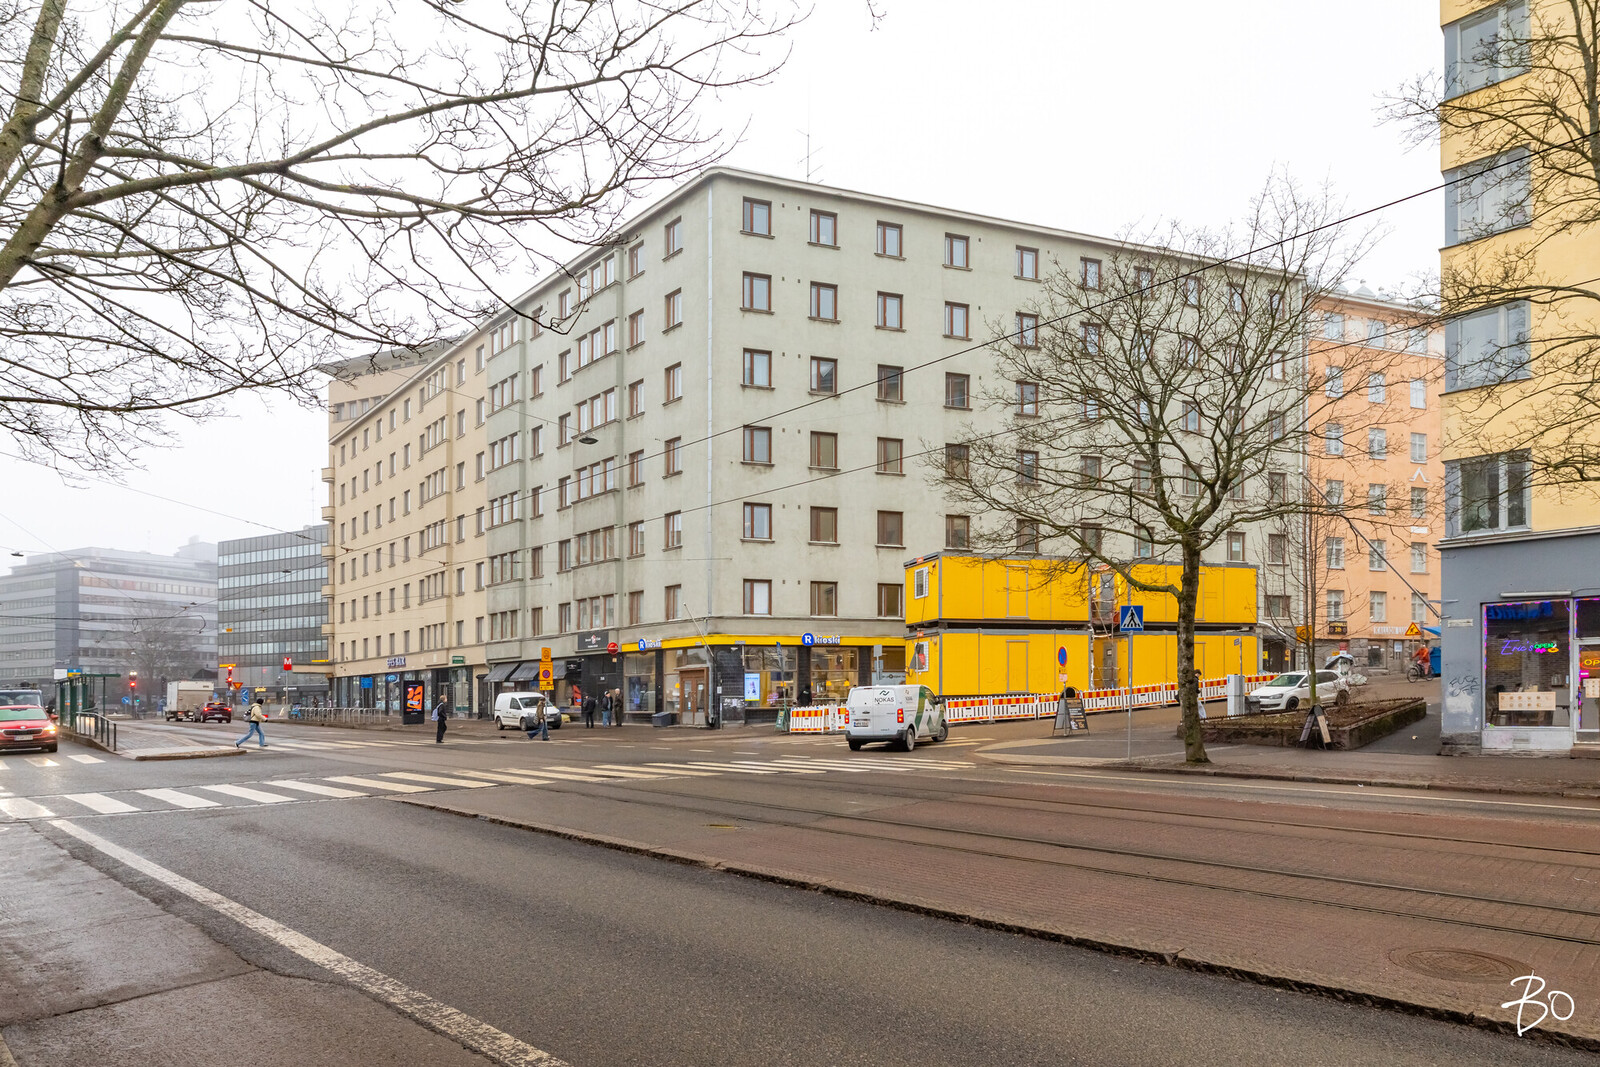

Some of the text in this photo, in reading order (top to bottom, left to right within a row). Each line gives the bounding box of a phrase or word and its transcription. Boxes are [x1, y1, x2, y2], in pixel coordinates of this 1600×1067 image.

[814, 635, 840, 645] kioski
[1501, 639, 1534, 655] Eric's
[284, 657, 291, 665] M
